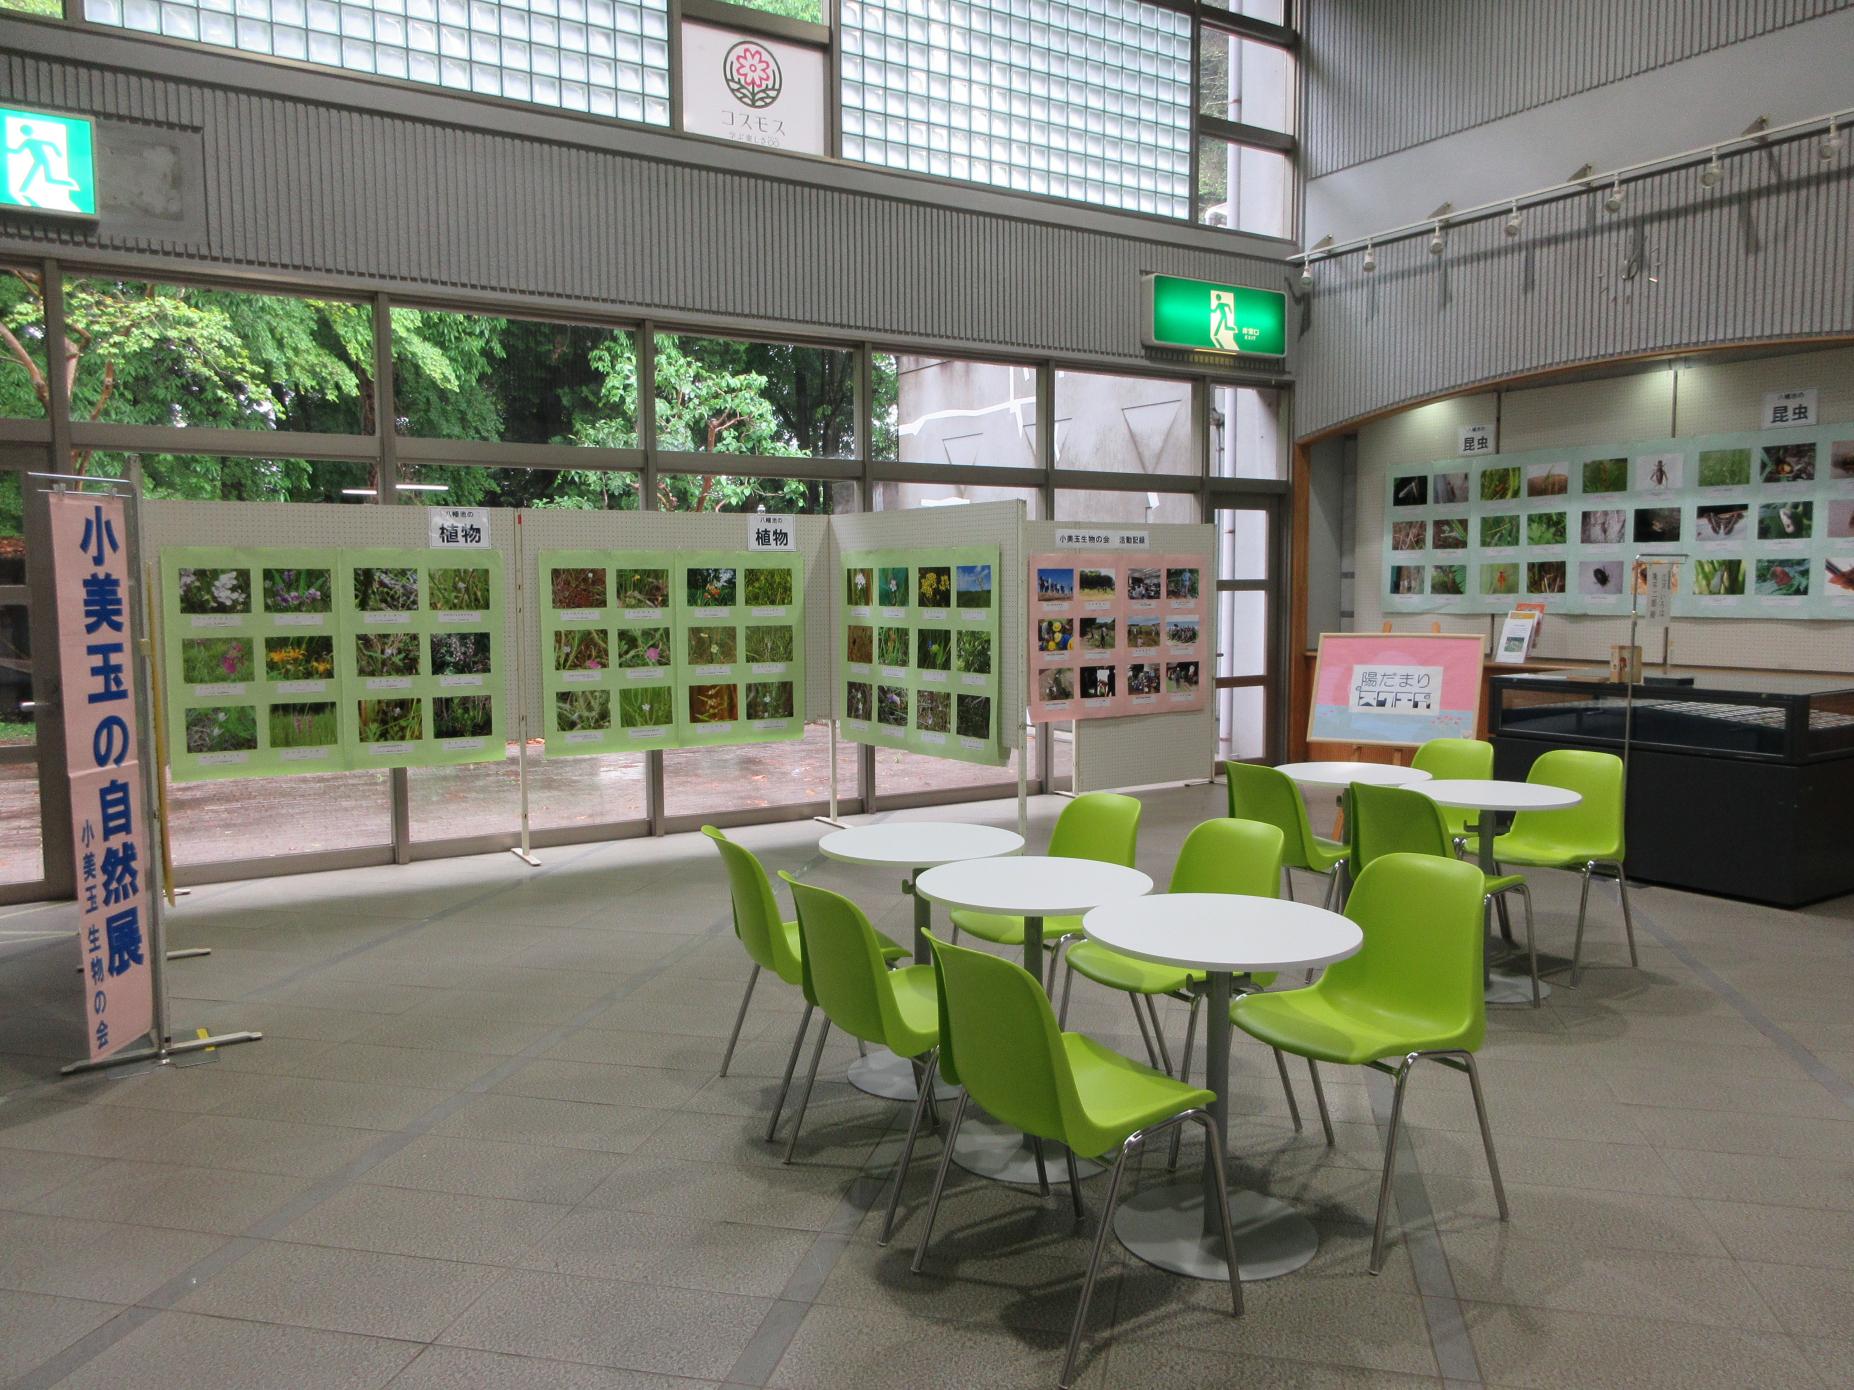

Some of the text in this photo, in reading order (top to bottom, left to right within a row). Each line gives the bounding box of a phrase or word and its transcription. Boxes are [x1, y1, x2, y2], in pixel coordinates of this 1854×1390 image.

[722, 110, 785, 137] コスモス
[1771, 404, 1808, 423] 昆虫
[1463, 436, 1489, 452] 昆虫
[439, 523, 482, 544] 植物
[755, 528, 789, 546] 植物
[1059, 535, 1145, 544] 小美玉生物の会 活動記録
[1361, 671, 1431, 688] 陽だまり
[79, 505, 145, 977] 小美玉の自然展
[81, 819, 110, 1048] 小美玉生物の会
